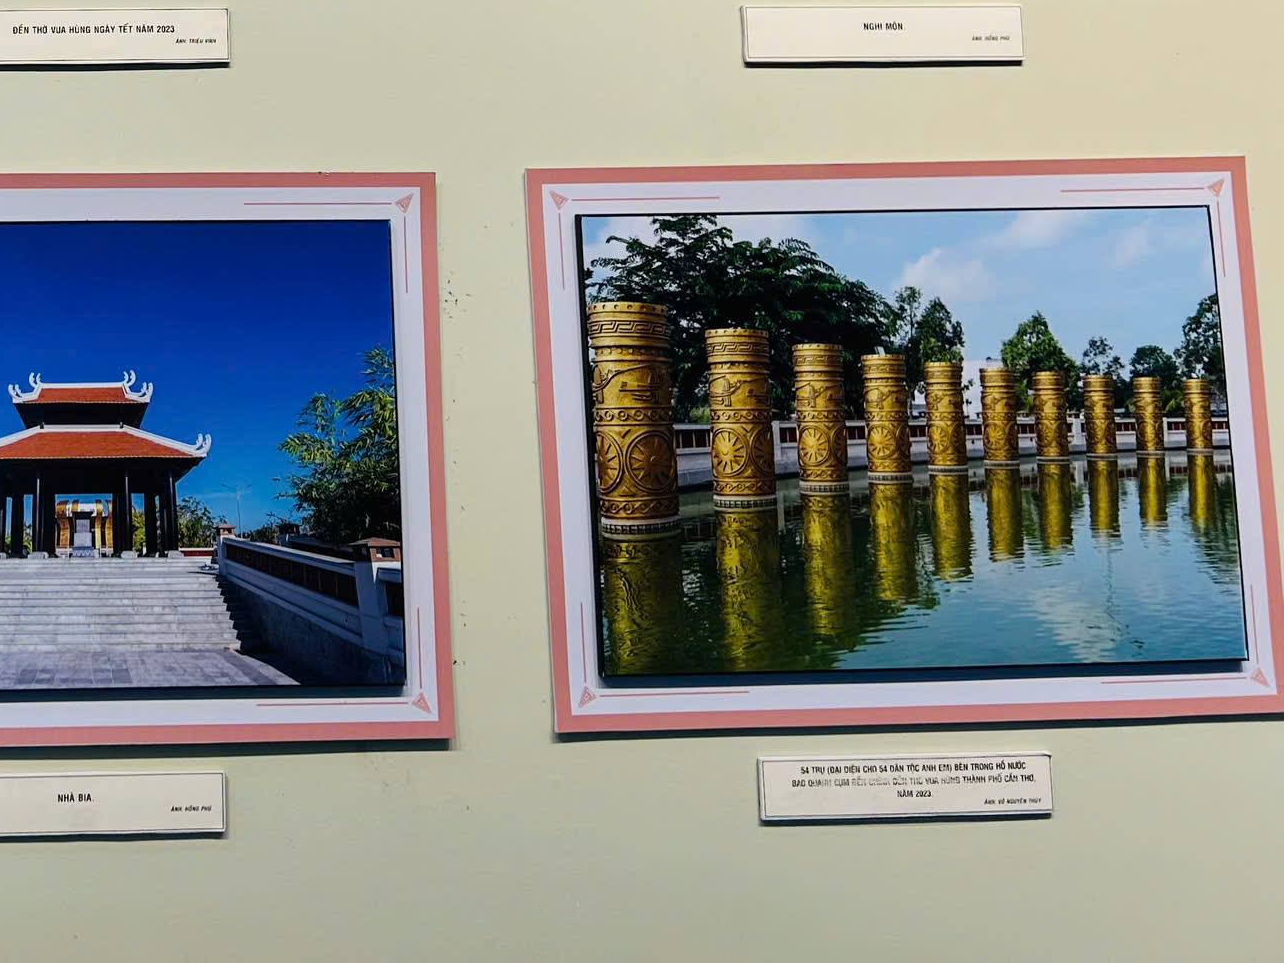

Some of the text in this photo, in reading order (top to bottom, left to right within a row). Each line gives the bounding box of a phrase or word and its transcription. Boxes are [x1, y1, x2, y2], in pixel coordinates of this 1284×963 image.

[50, 26, 66, 34] VUA
[68, 24, 91, 34] HÙNG
[94, 24, 115, 33] NGÀY
[119, 23, 133, 33] TẾT
[57, 792, 75, 802] NHÀ
